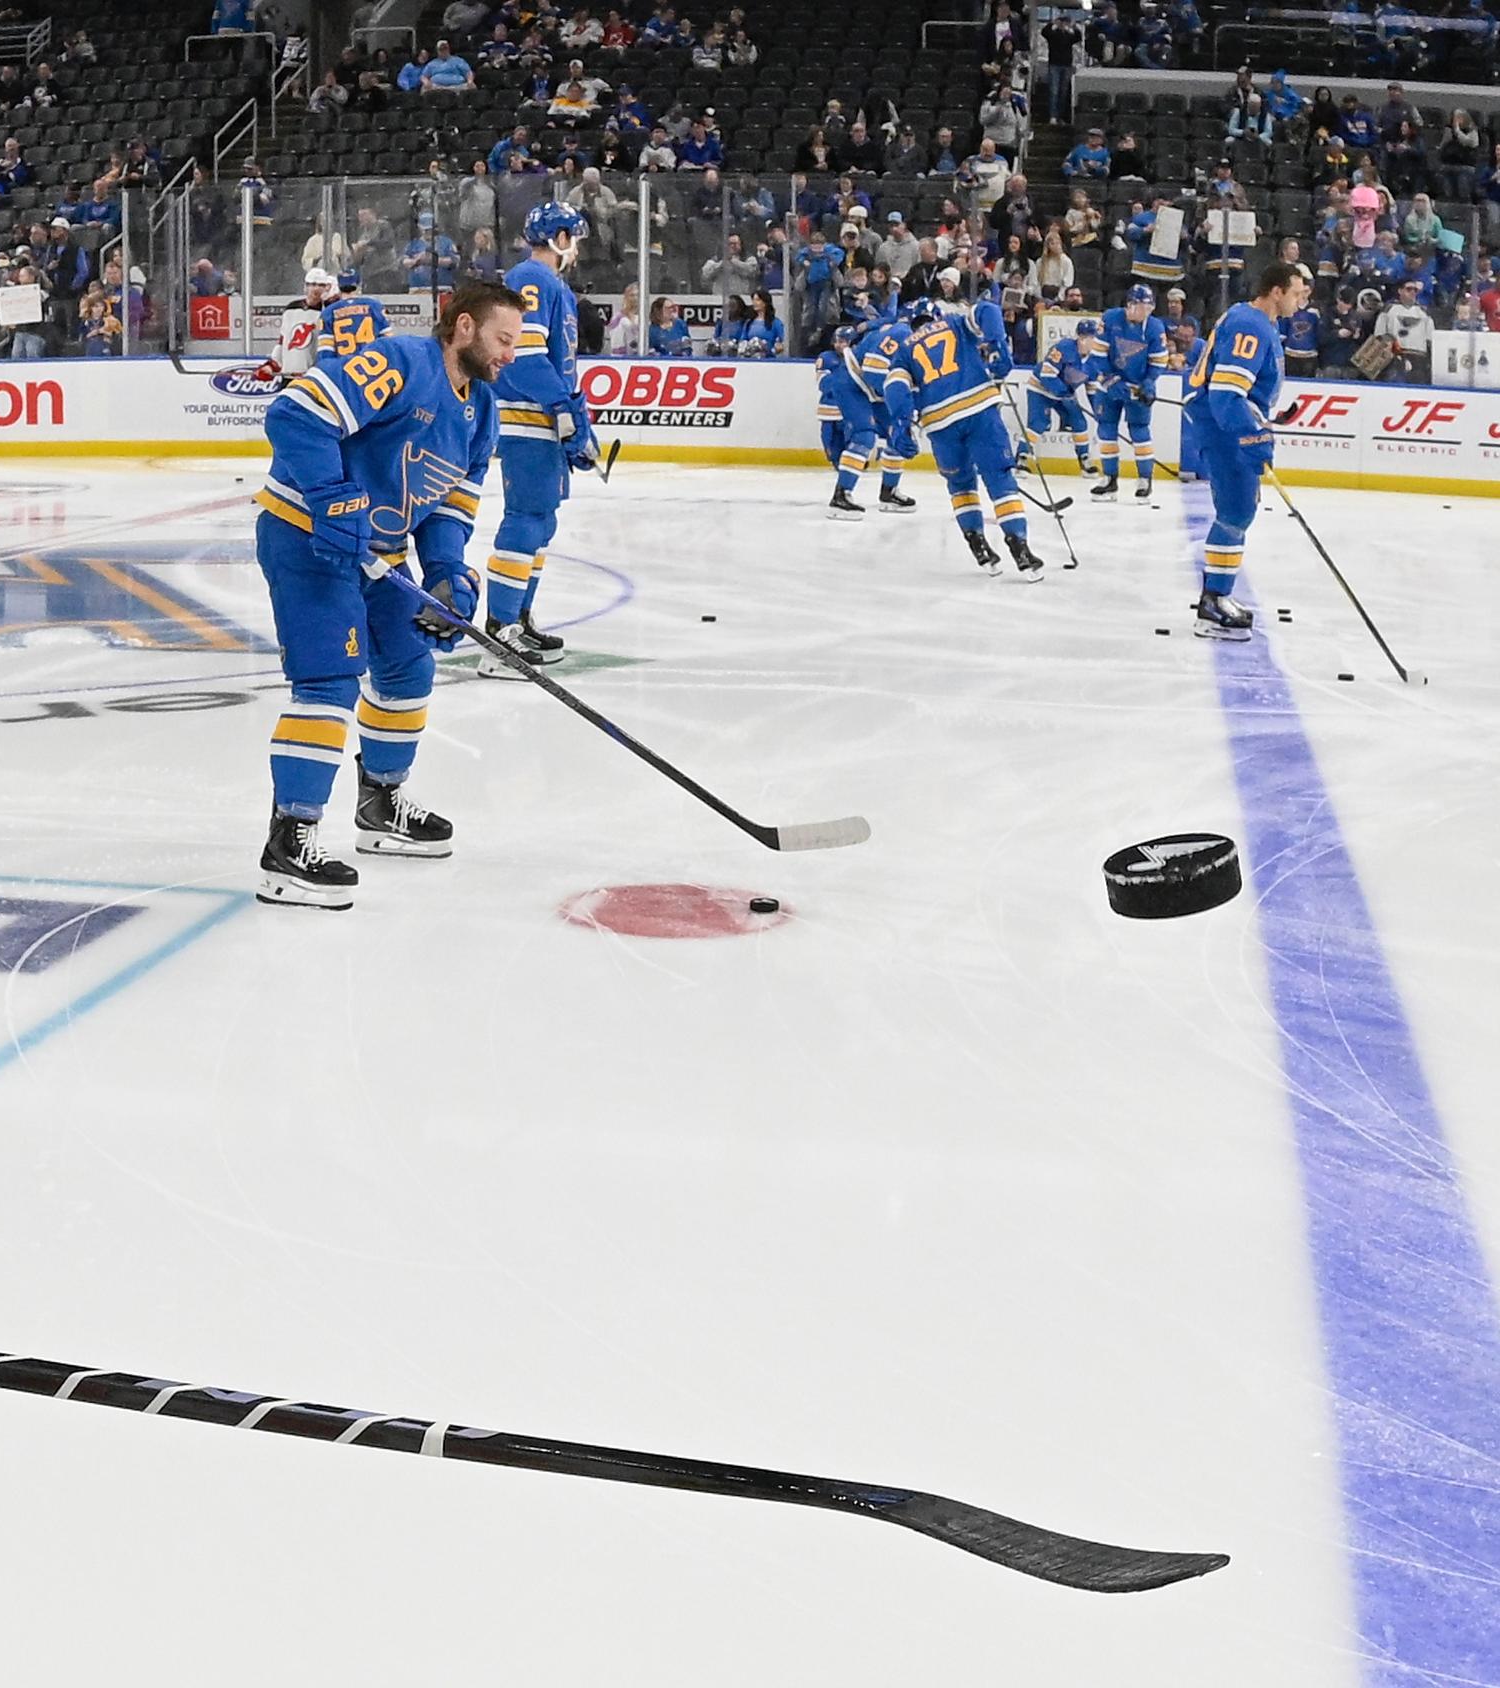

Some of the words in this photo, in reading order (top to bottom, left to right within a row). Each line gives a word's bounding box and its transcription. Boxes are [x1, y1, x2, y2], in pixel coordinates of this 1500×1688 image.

[334, 316, 375, 355] 54
[1232, 333, 1259, 359] 10
[912, 330, 960, 384] 17
[226, 374, 283, 393] Ford
[343, 351, 404, 410] 26
[183, 404, 209, 414] YOUR
[211, 404, 251, 415] QUALITY
[597, 411, 644, 425] AUTO
[648, 411, 726, 427] CENTERS
[1382, 400, 1465, 435] J.F.
[1377, 444, 1457, 456] ELECTRIC
